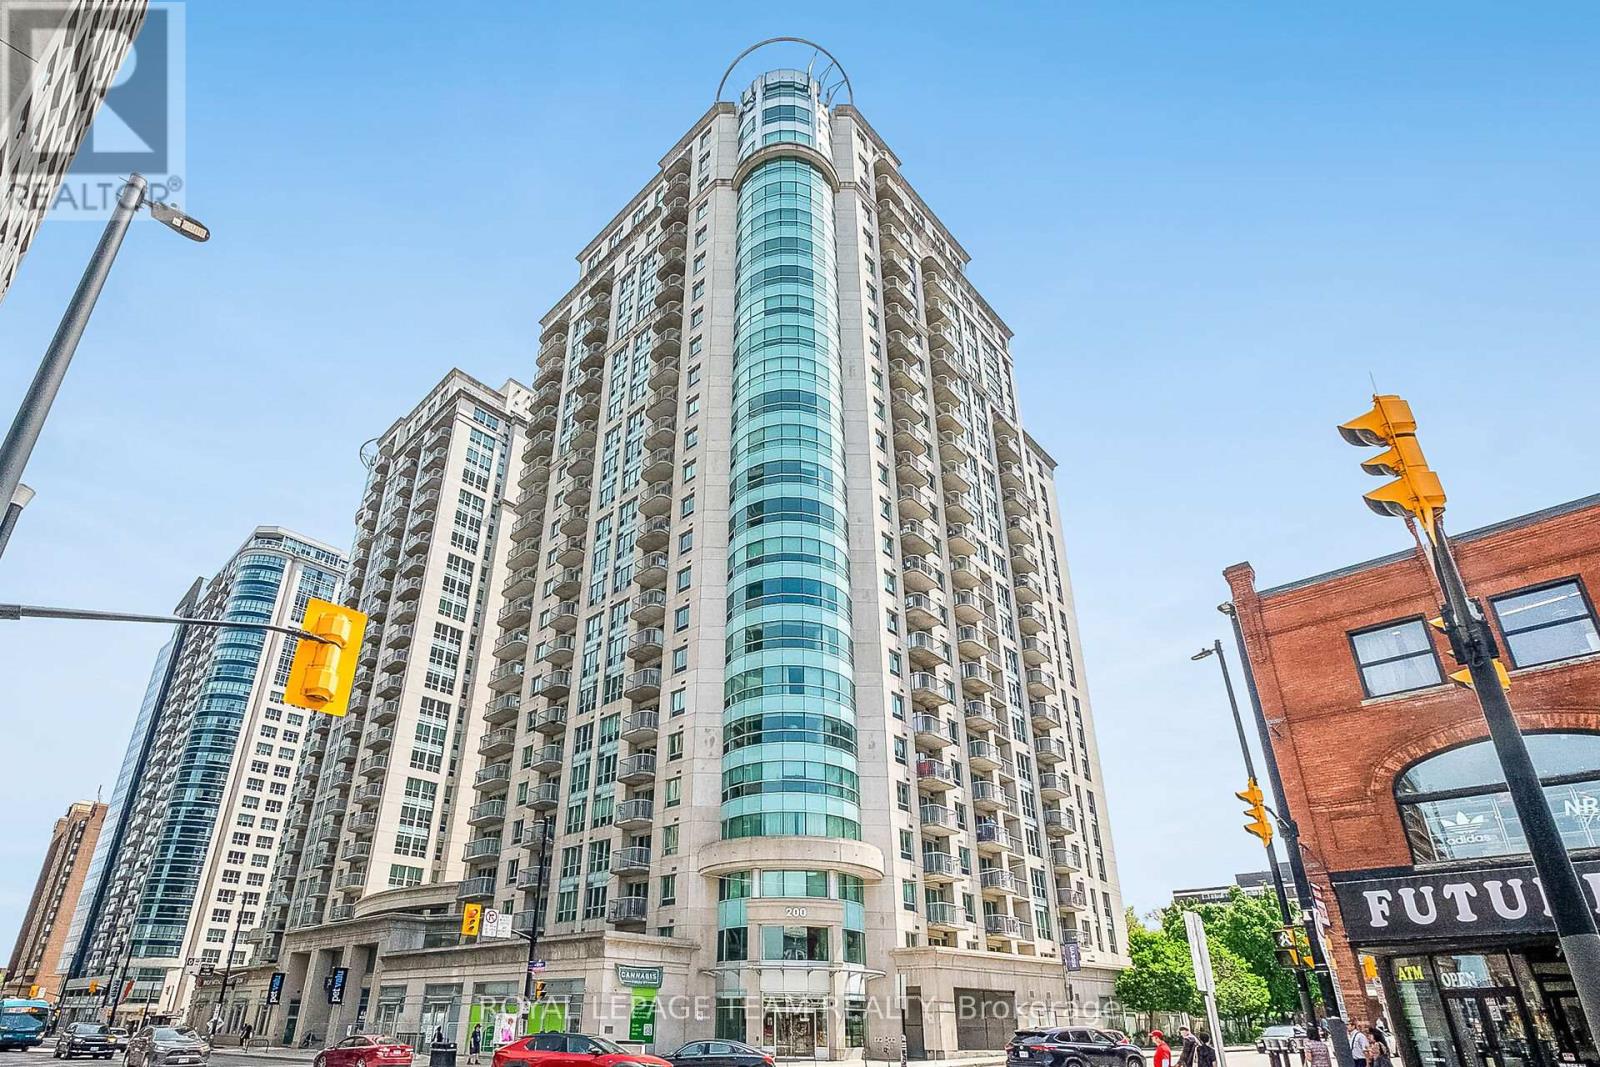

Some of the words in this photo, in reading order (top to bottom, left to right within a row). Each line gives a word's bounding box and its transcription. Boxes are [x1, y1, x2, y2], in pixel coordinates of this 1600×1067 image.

[1447, 833, 1491, 846] adidas
[785, 906, 806, 917] 200
[621, 971, 657, 980] CANNABIS
[1397, 965, 1425, 981] ATM
[1441, 972, 1478, 988] OPEN
